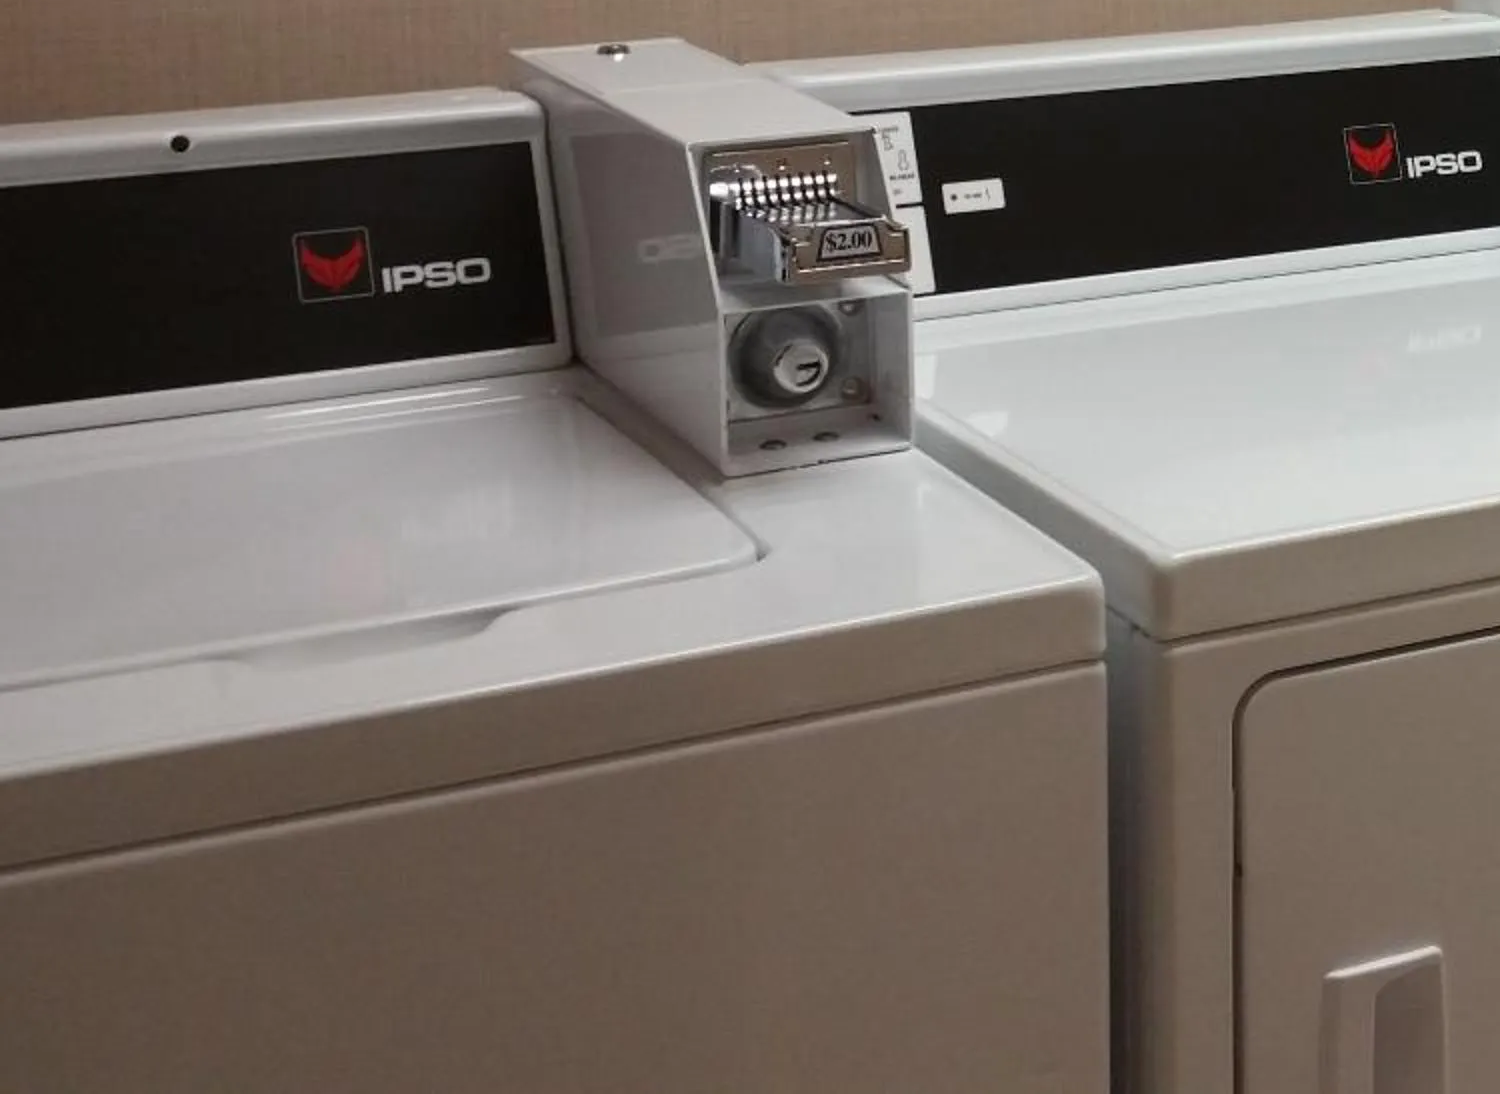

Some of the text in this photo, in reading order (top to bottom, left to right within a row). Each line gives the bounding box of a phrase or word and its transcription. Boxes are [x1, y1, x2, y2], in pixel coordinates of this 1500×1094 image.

[1406, 150, 1483, 179] IPSO
[825, 231, 873, 253] $2.00
[381, 257, 491, 293] IPSO
